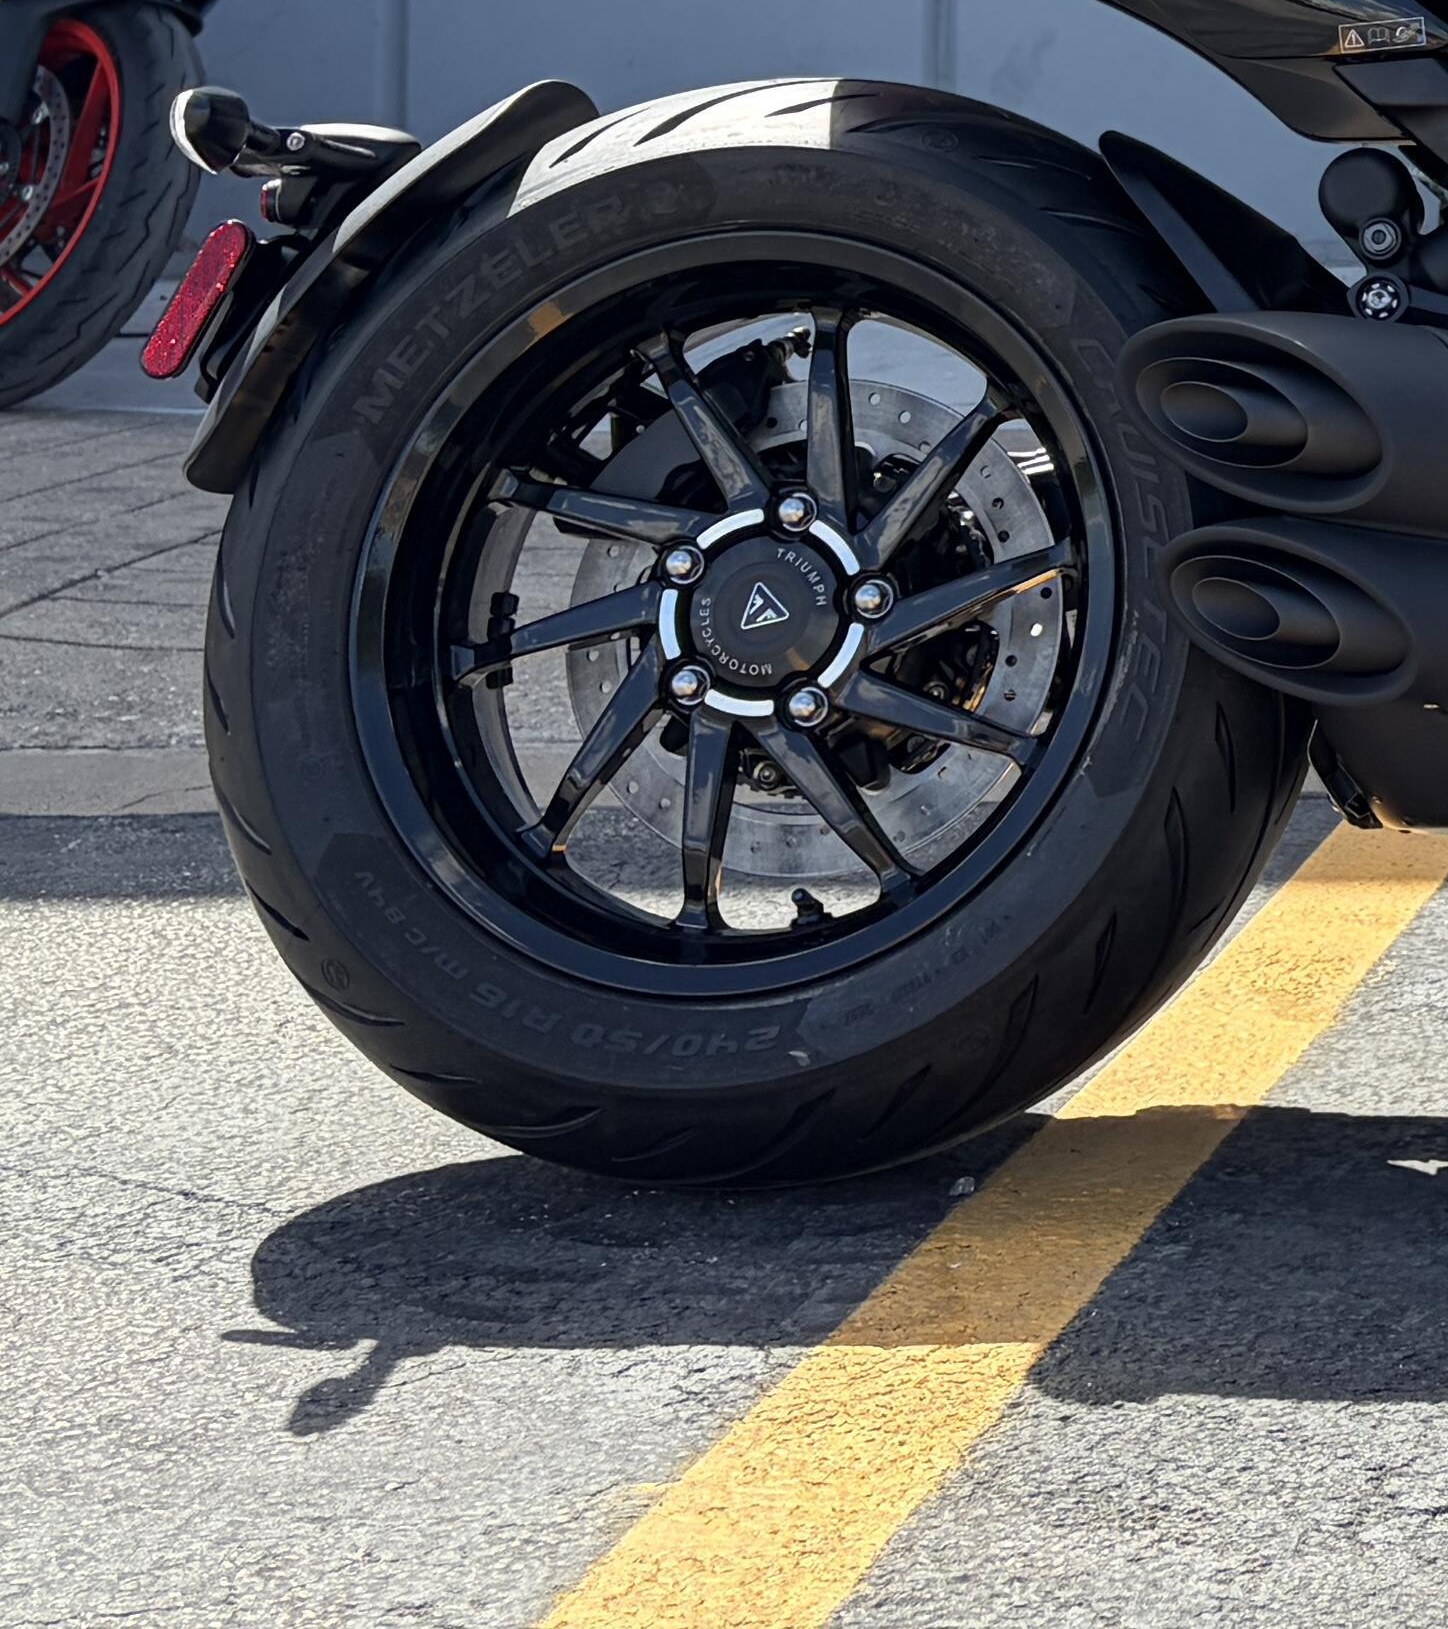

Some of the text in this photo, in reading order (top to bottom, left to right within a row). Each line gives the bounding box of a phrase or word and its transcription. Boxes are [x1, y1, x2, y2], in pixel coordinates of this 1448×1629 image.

[352, 193, 628, 425] METZELER
[777, 547, 828, 607] TRIUMPH
[699, 596, 773, 676] MOTORCYCLES
[467, 981, 562, 1036] R16
[570, 1021, 783, 1058] 240/50
